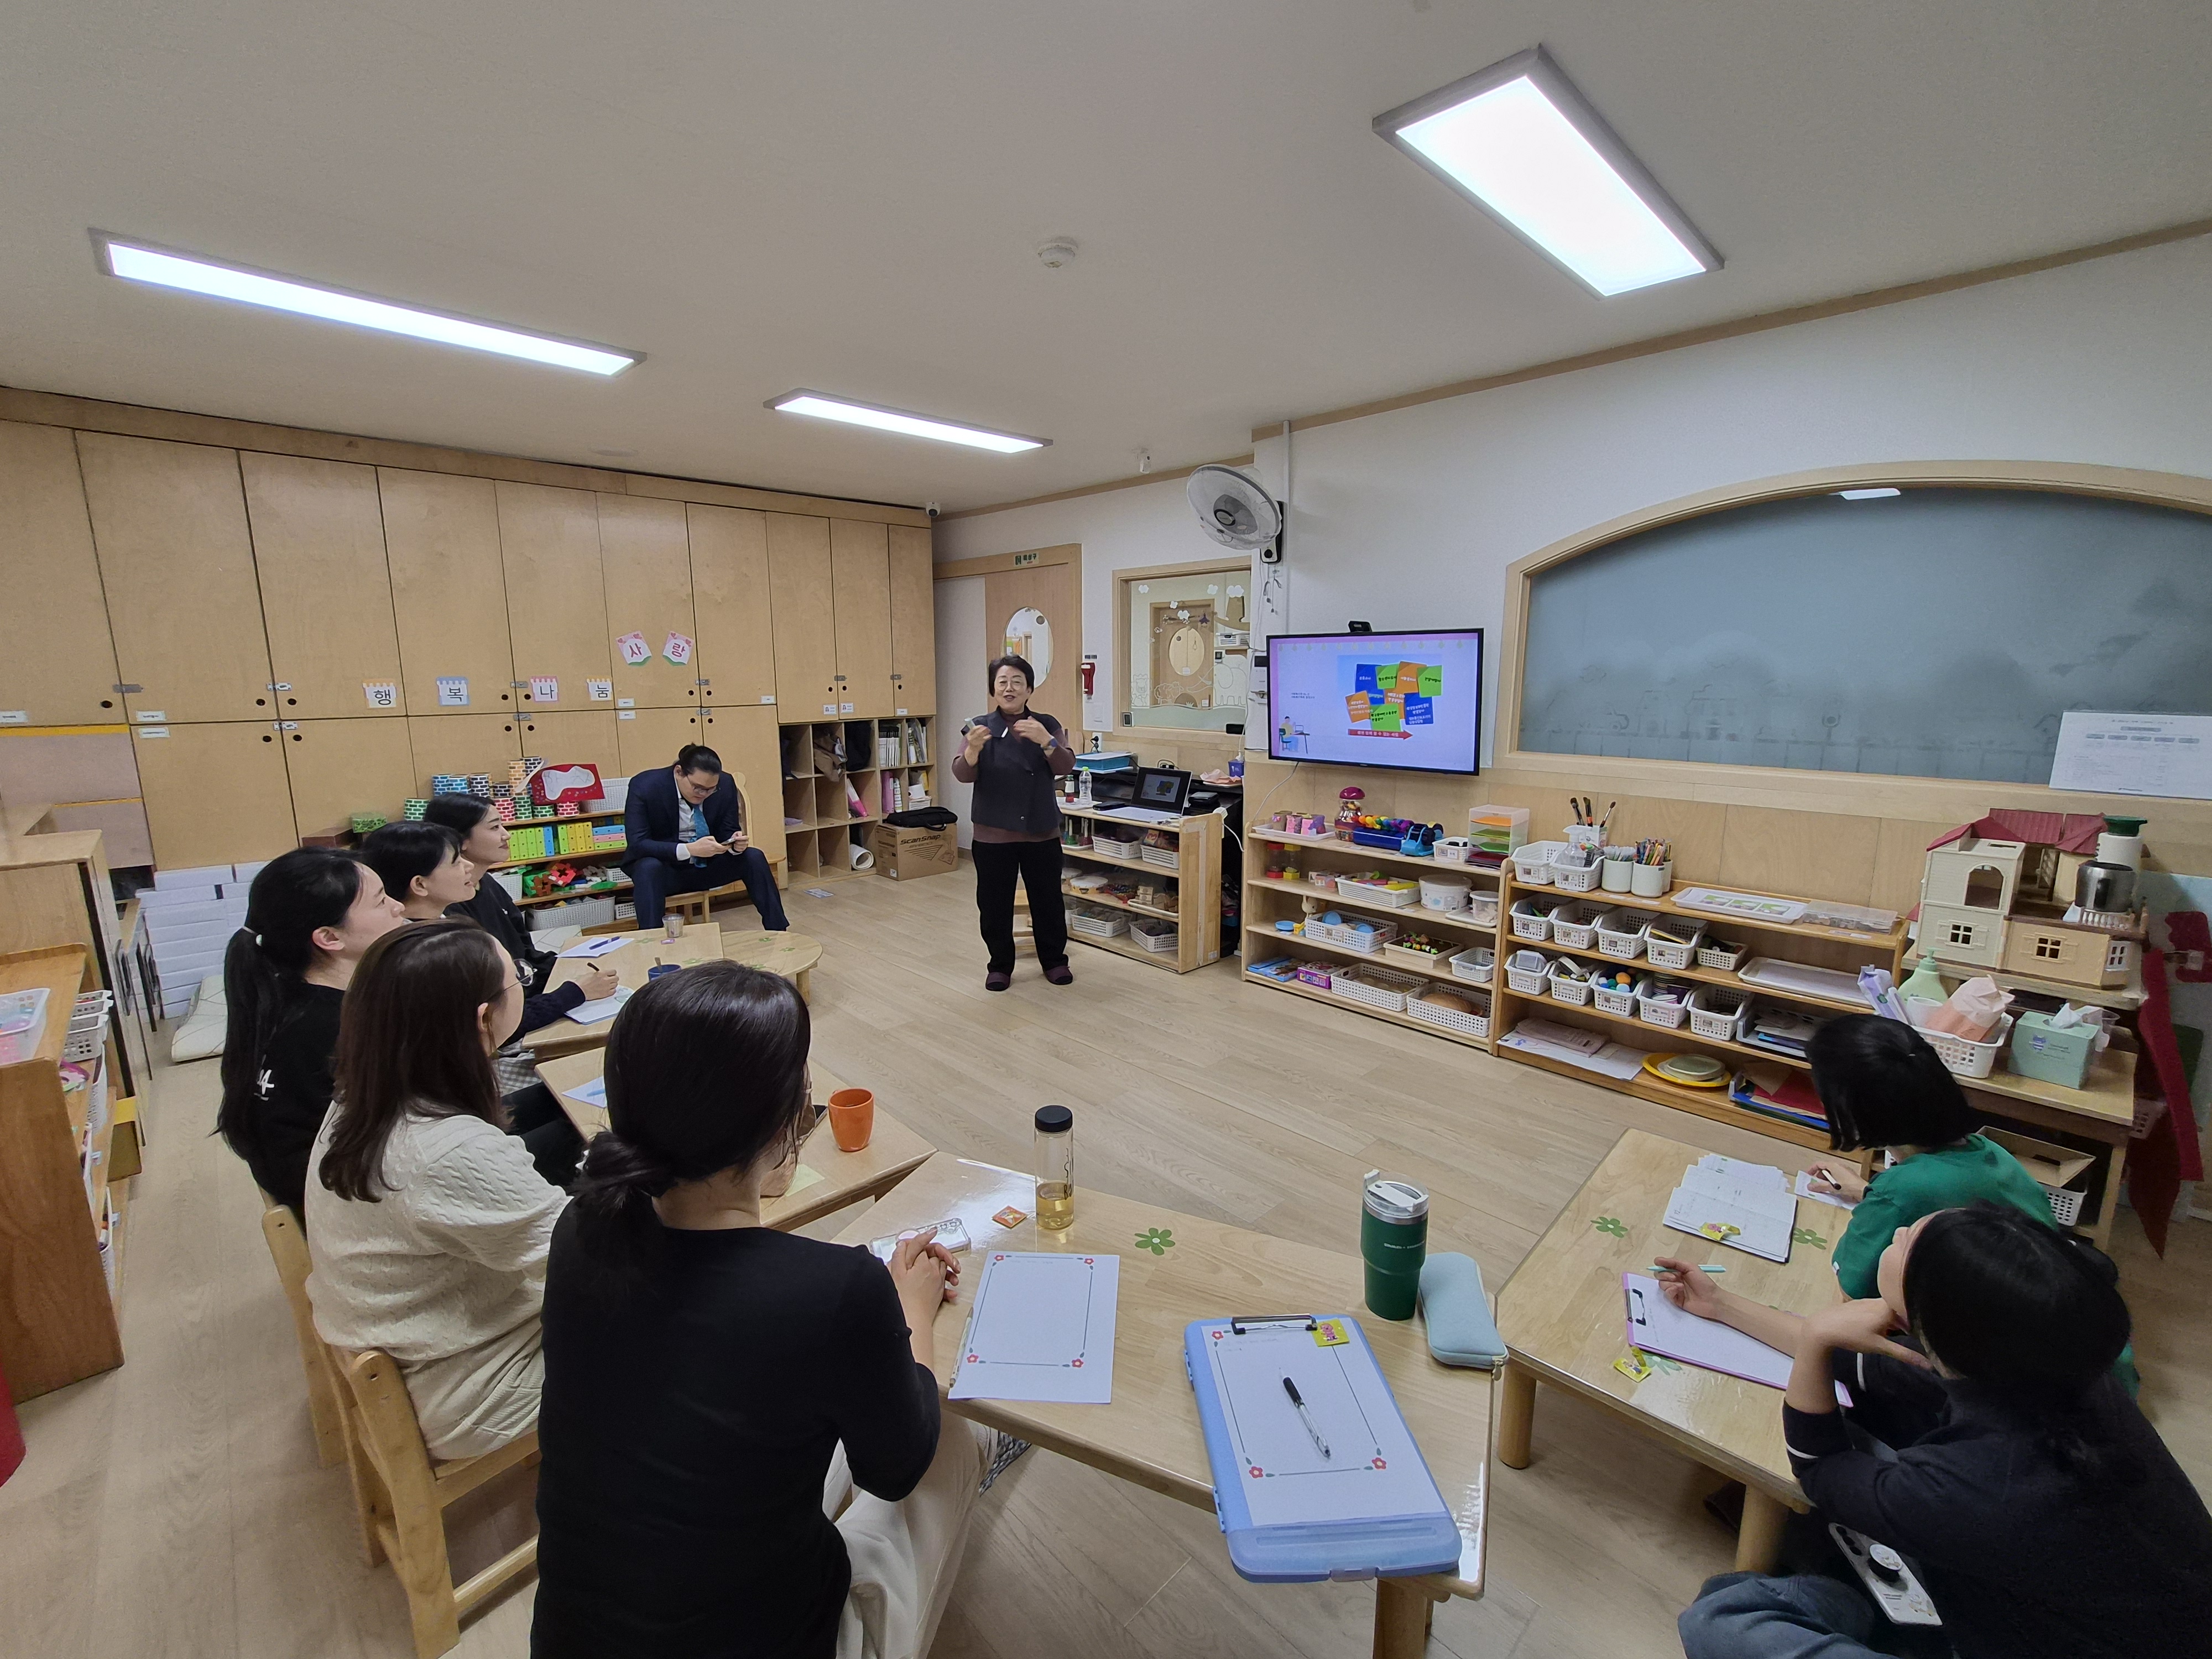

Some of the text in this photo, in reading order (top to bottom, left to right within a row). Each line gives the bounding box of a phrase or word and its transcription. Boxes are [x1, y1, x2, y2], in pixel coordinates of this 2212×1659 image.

[629, 643, 686, 658] 사 랑
[373, 684, 609, 706] 행 복 나 눔
[900, 834, 941, 845] ScanSnap
